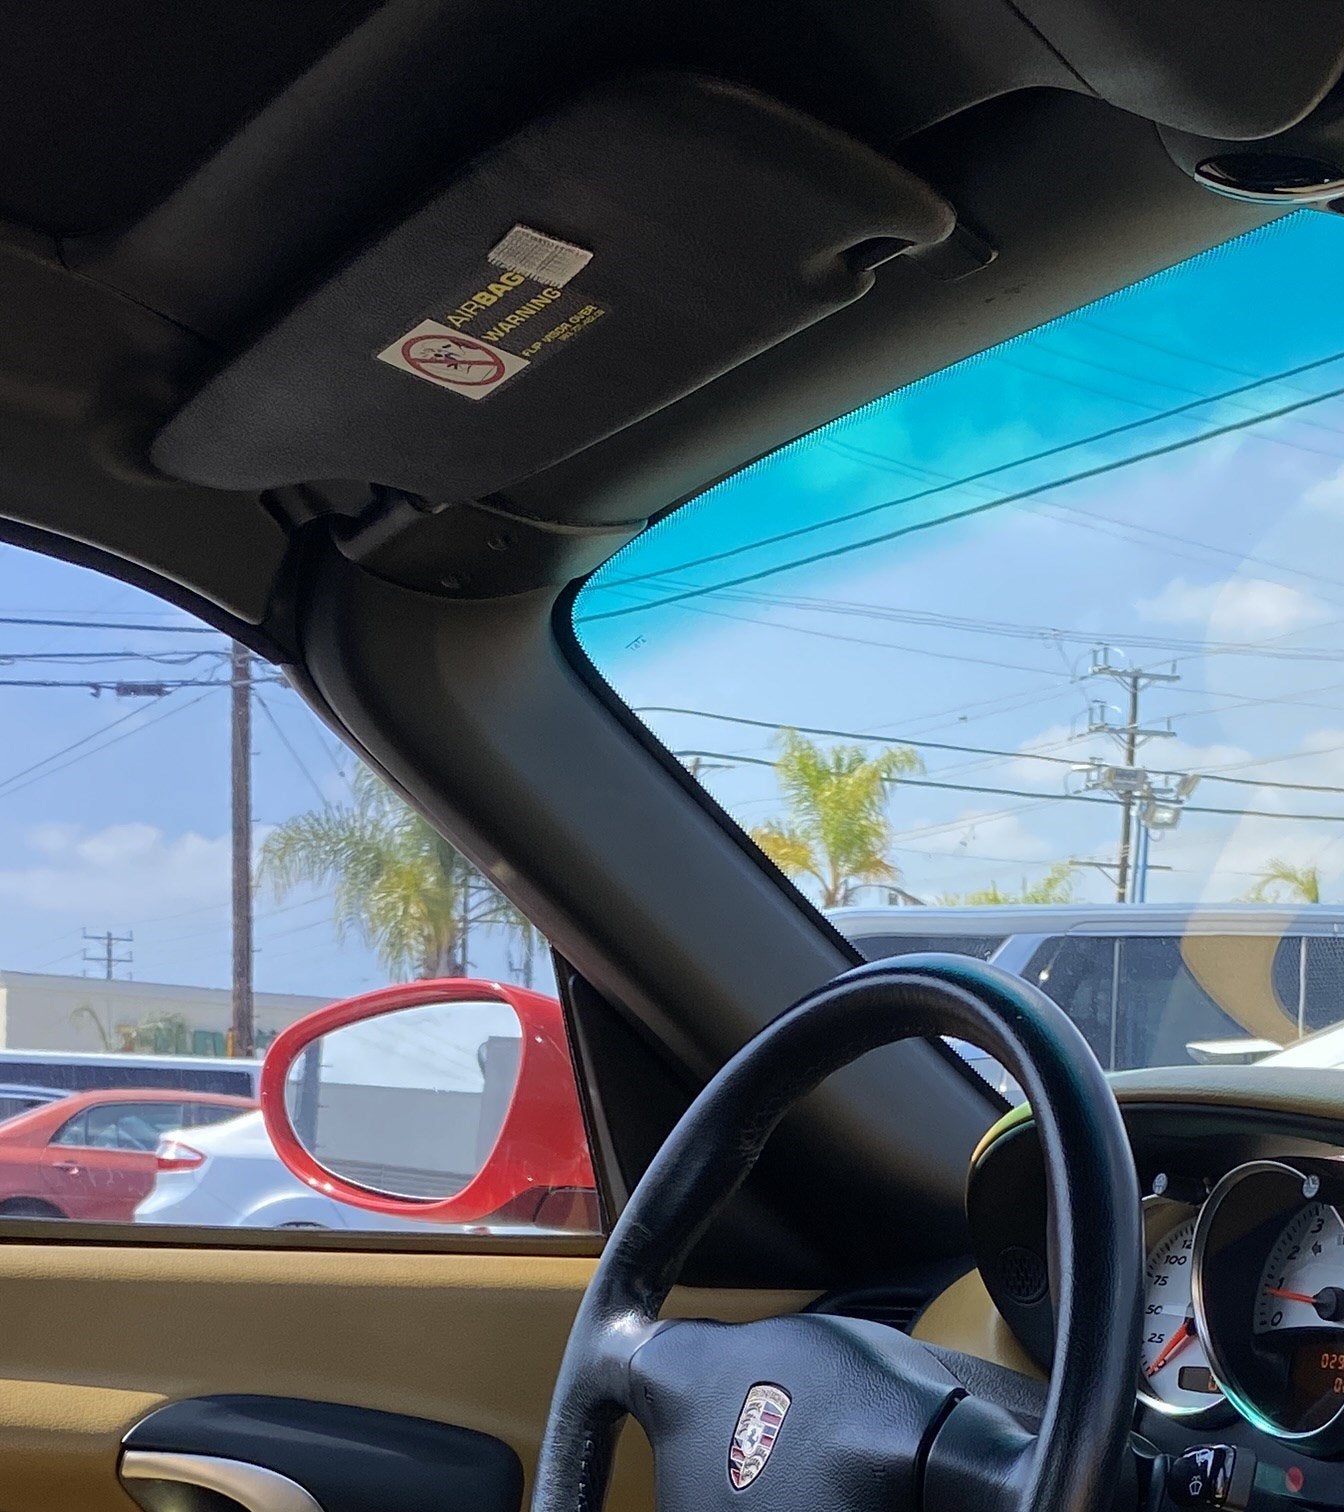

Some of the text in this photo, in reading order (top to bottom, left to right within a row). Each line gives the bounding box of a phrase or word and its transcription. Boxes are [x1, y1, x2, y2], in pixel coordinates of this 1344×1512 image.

[447, 271, 526, 328] AIRBAG
[481, 287, 562, 342] WARNING
[521, 341, 542, 357] FLIP
[541, 322, 572, 343] VISOR
[568, 304, 598, 324] OVER
[1310, 1218, 1324, 1234] 3
[1164, 1254, 1187, 1266] 100
[1287, 1245, 1300, 1260] 2
[1153, 1275, 1169, 1286] 75
[1145, 1304, 1164, 1315] 50
[1271, 1311, 1283, 1326] 0
[1147, 1333, 1165, 1344] 25
